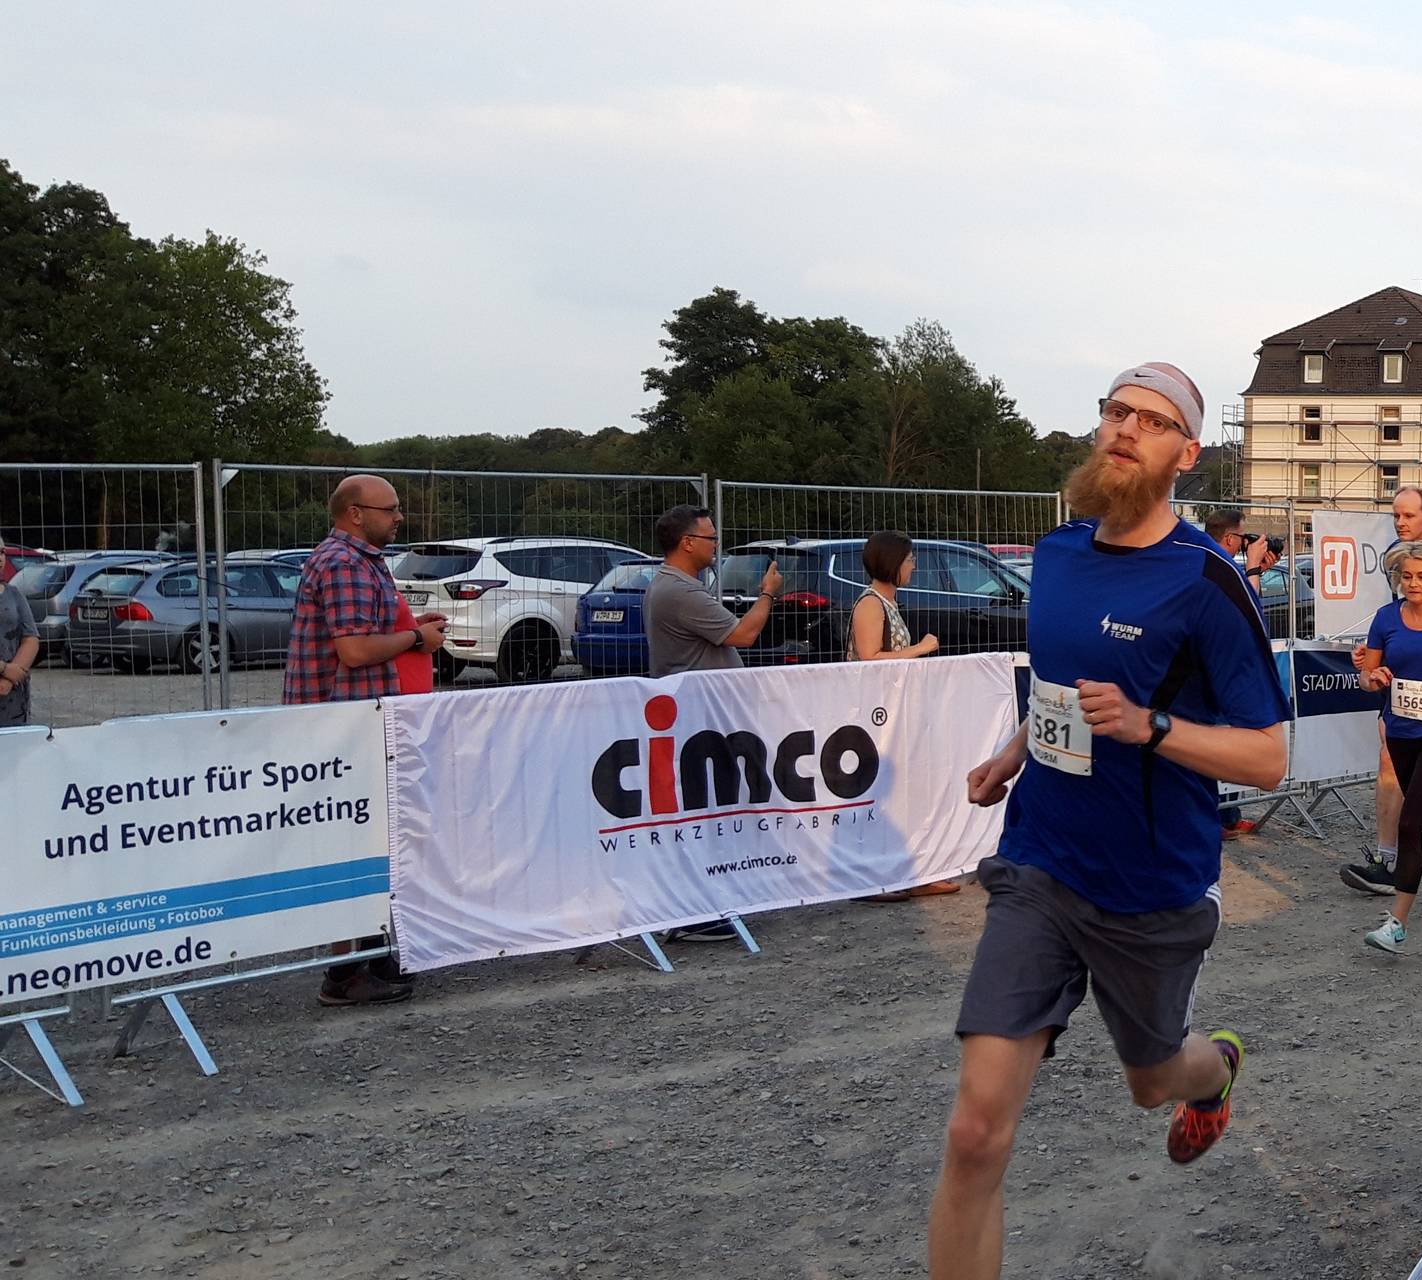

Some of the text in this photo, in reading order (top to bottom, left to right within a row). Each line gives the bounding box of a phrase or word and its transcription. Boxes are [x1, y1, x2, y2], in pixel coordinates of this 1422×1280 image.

[1110, 630, 1136, 641] TEAM
[1111, 622, 1143, 636] WURM
[1302, 673, 1360, 691] STADTWE
[592, 695, 879, 818] cimco
[61, 755, 353, 815] Agentur für Sport-
[44, 795, 370, 859] und Eventmarketing
[96, 901, 108, 914] &
[111, 894, 168, 913] -service
[1, 906, 224, 950] Funktionsbekleidung Fotobox
